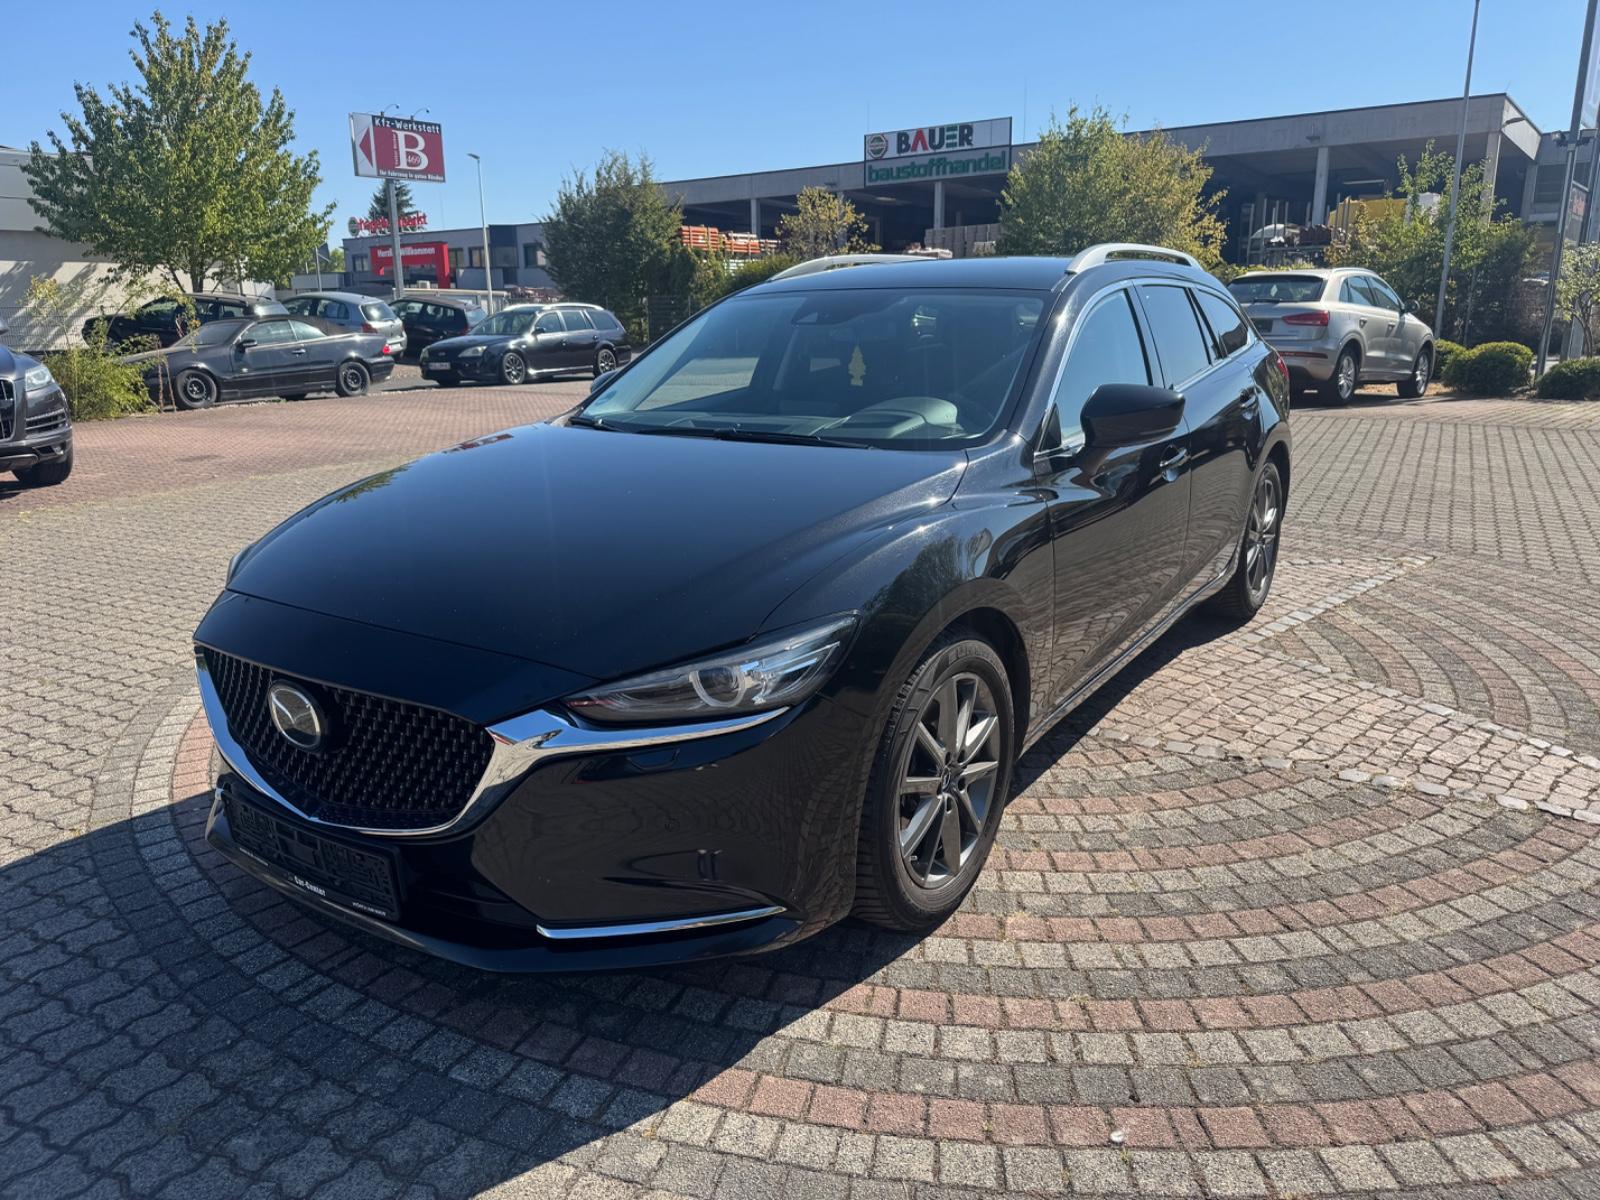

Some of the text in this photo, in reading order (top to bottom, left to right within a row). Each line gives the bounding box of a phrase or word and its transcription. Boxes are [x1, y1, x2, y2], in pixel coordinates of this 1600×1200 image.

[374, 117, 440, 134] Kfz-Werkstatt
[897, 124, 974, 154] BAUER
[391, 129, 429, 170] B
[868, 150, 1006, 183] baustoffhandel
